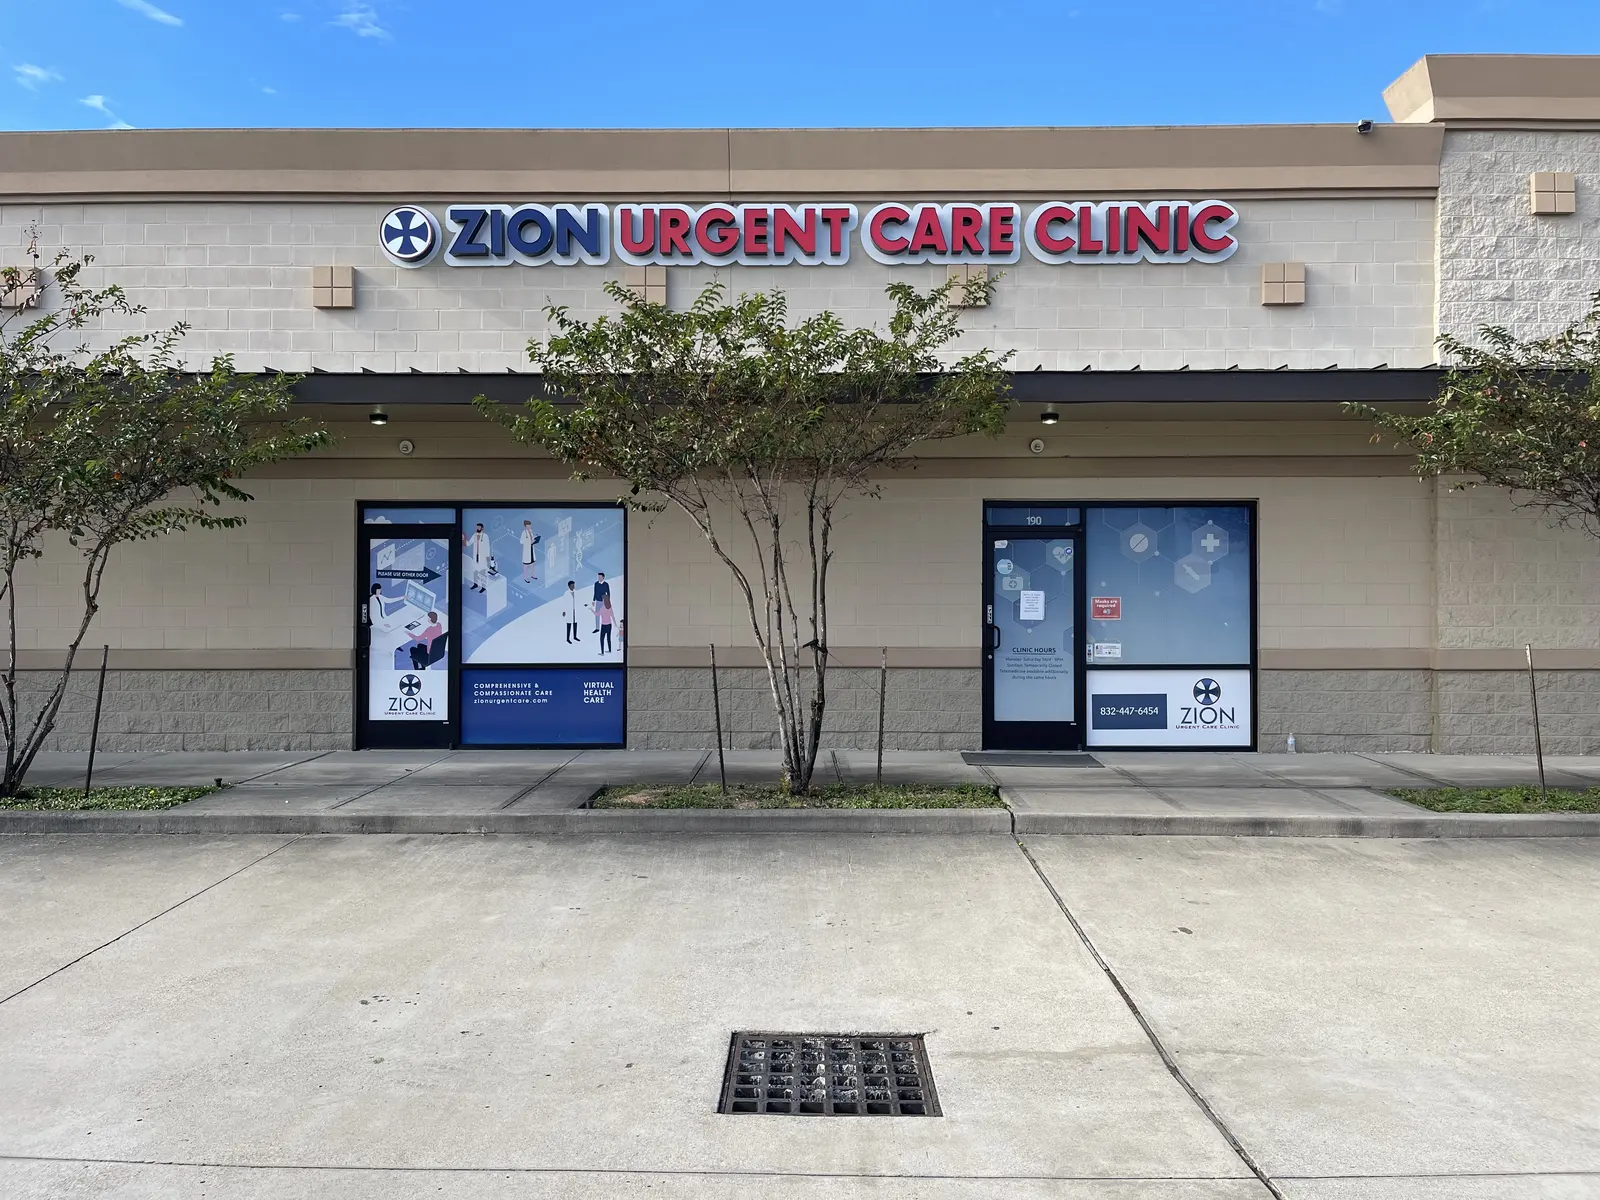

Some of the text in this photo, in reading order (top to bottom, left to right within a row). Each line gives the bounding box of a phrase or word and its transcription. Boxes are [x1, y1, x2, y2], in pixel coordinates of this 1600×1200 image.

[449, 204, 1235, 257] ZION URGENT CARE CLINIC
[1026, 516, 1042, 526] 190
[388, 697, 432, 711] ZION
[1100, 706, 1159, 716] 832-447-6454
[1180, 707, 1235, 724] ZION
